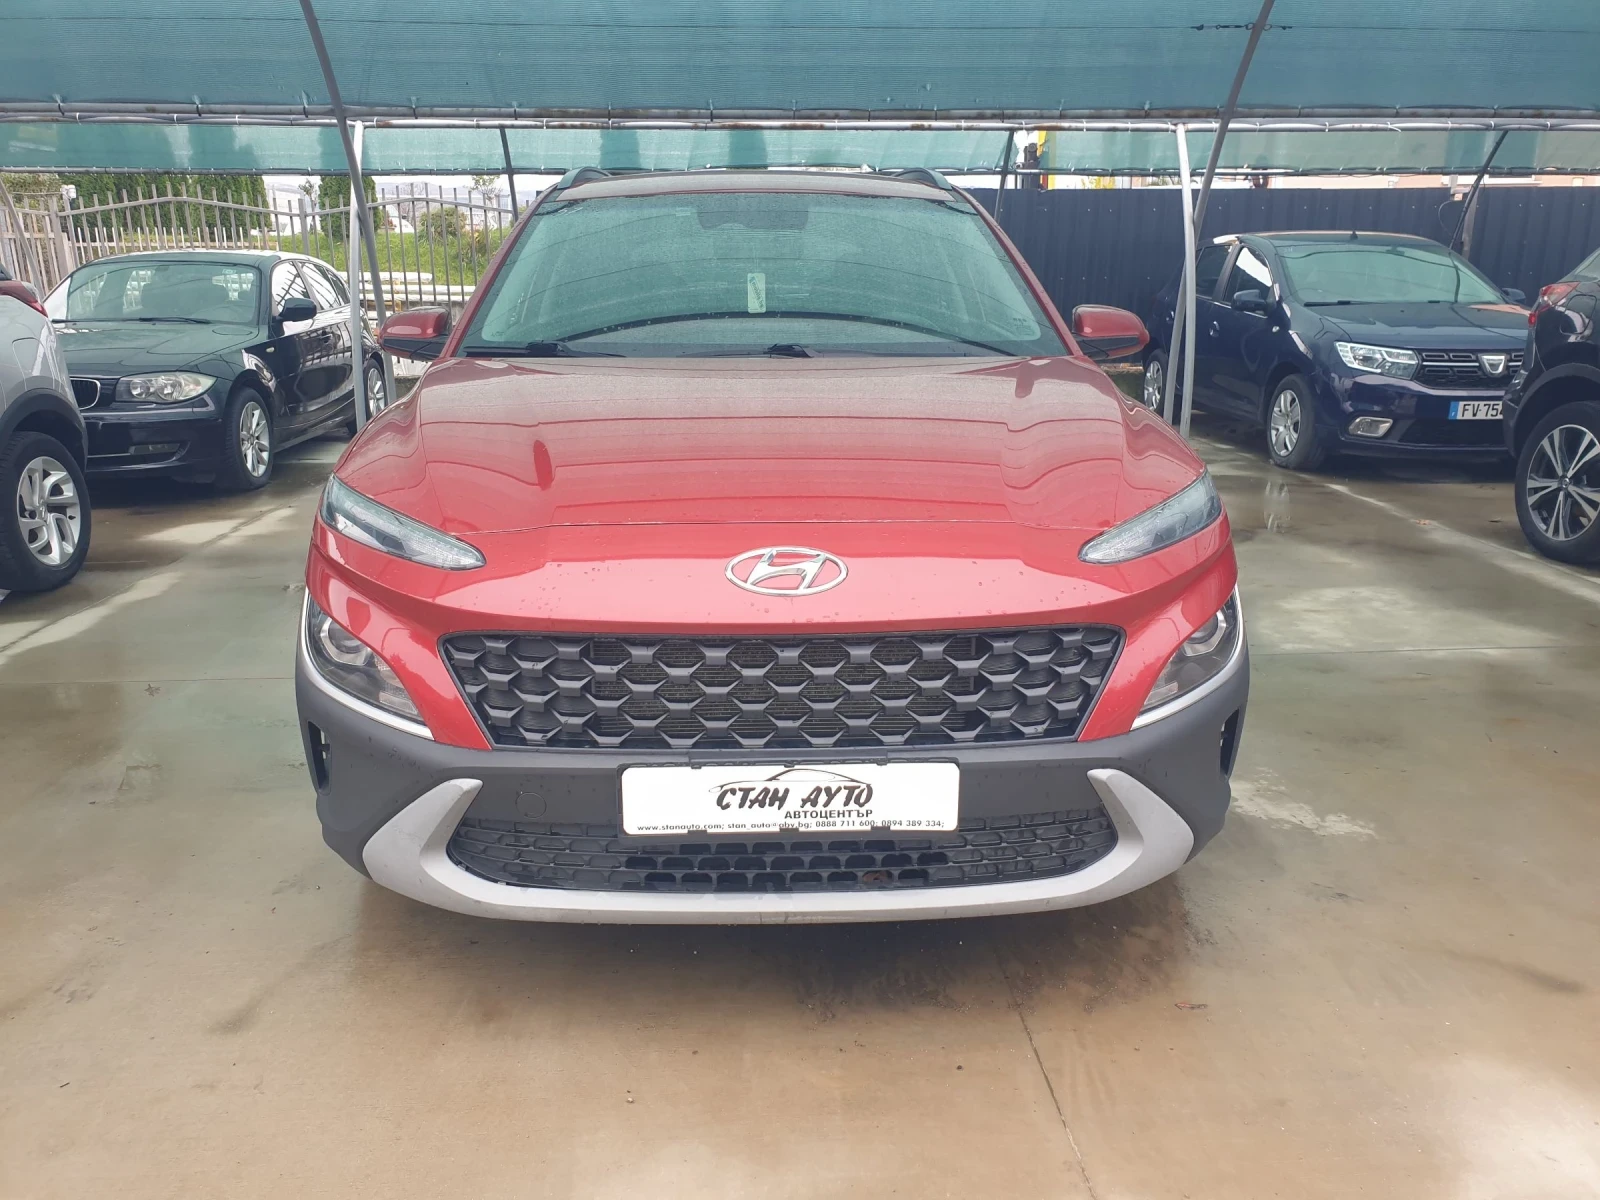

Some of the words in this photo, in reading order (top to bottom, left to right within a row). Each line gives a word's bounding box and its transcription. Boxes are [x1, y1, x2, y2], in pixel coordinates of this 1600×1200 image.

[716, 787, 790, 811] СТАН
[800, 784, 874, 808] АУТО
[784, 809, 873, 820] АВТОЦЕНТЪР
[637, 823, 725, 831] www.stanauto.com;
[815, 820, 837, 828] 0888
[881, 820, 903, 828] 0894
[925, 820, 945, 828] 334;
